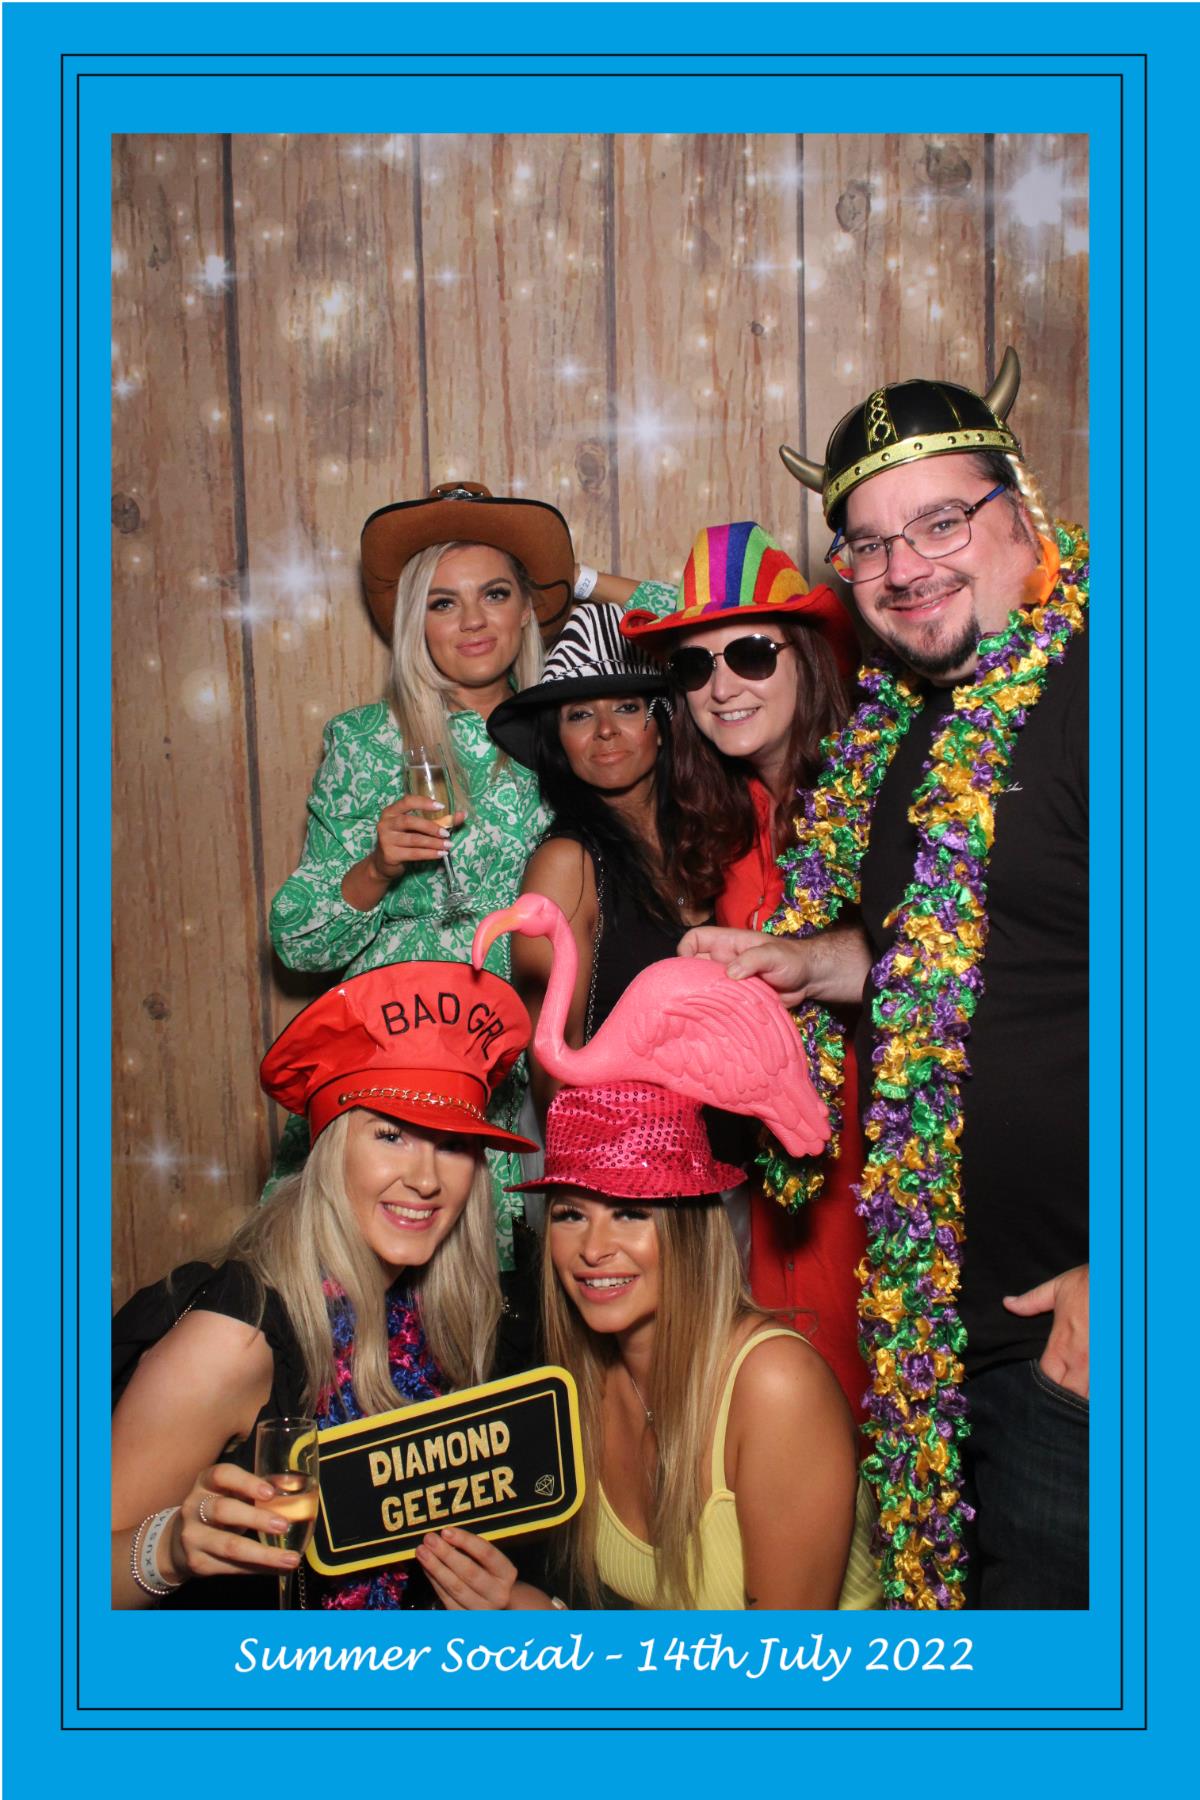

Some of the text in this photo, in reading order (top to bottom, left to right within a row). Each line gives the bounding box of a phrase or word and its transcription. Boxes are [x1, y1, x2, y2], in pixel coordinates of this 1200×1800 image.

[381, 992, 460, 1036] BAD
[368, 1420, 511, 1488] DIAMOND
[381, 1465, 518, 1533] GEEZER
